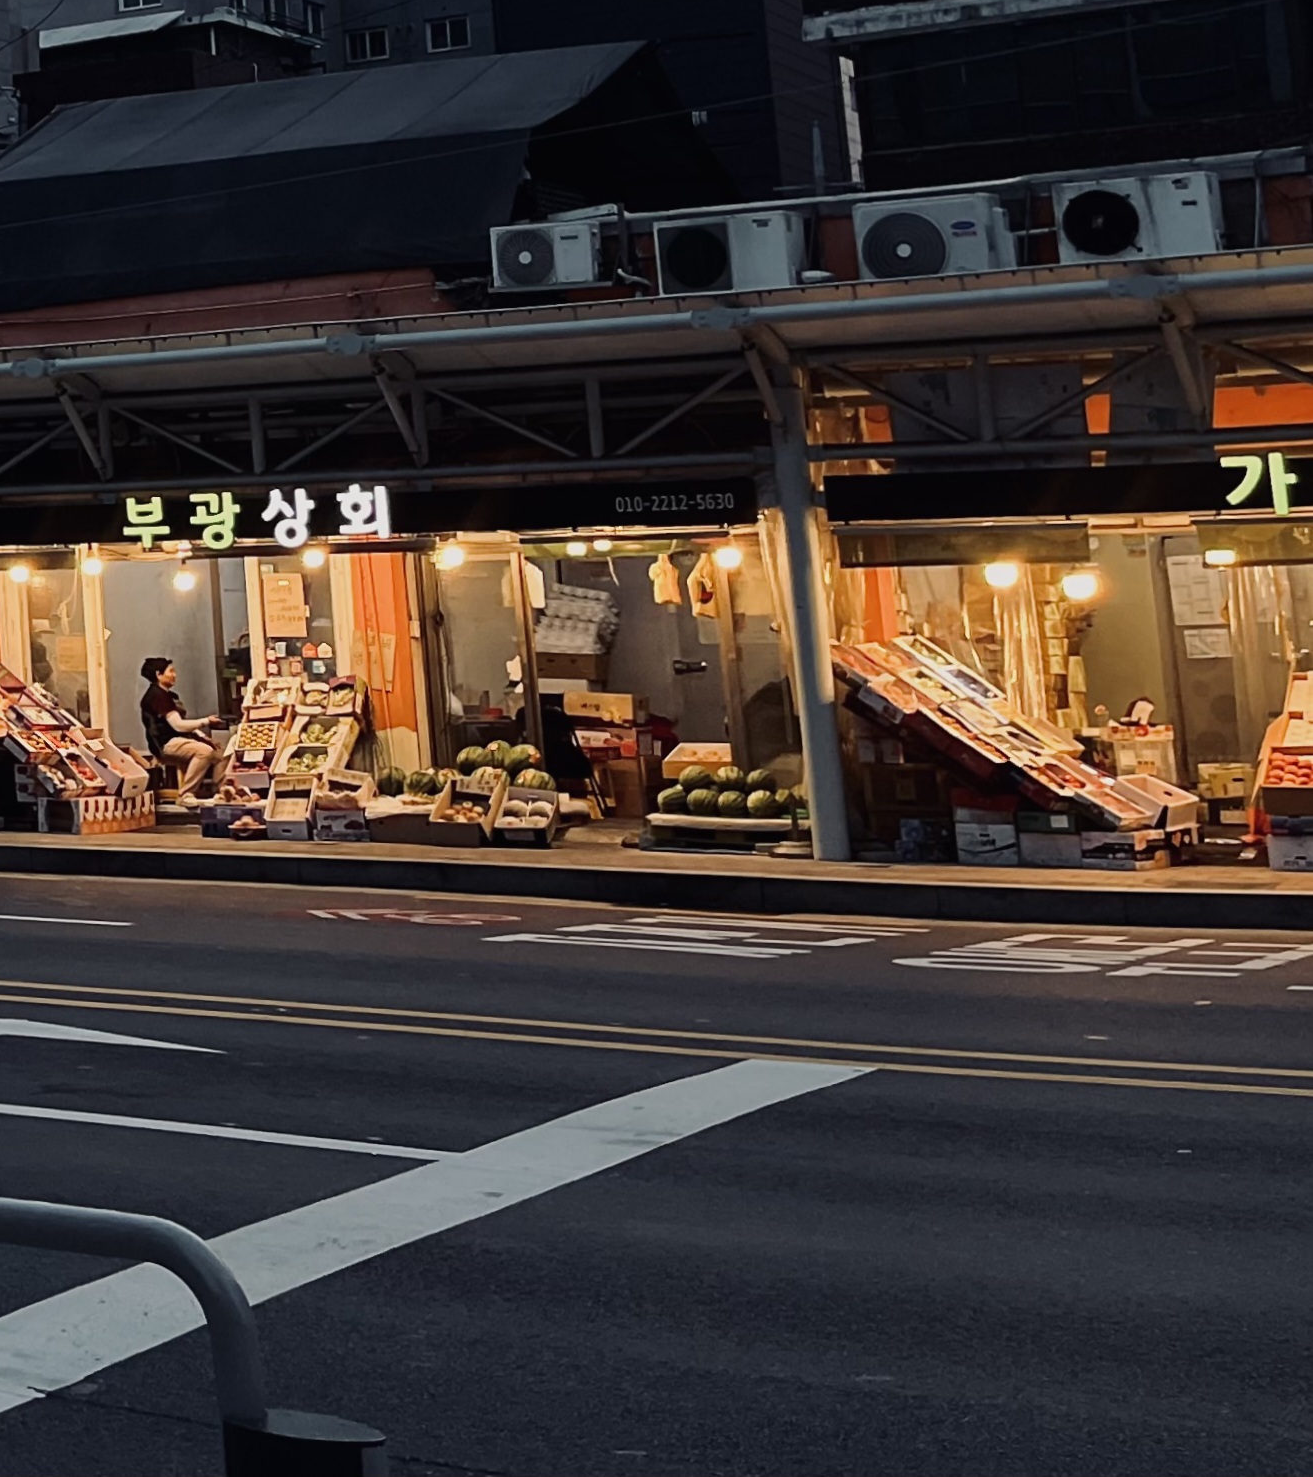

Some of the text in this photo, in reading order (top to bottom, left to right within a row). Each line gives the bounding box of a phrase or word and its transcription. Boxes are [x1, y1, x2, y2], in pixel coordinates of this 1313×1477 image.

[615, 493, 735, 513] 010-2212-5630
[1219, 451, 1299, 516] 가
[123, 483, 391, 550] 부광상회
